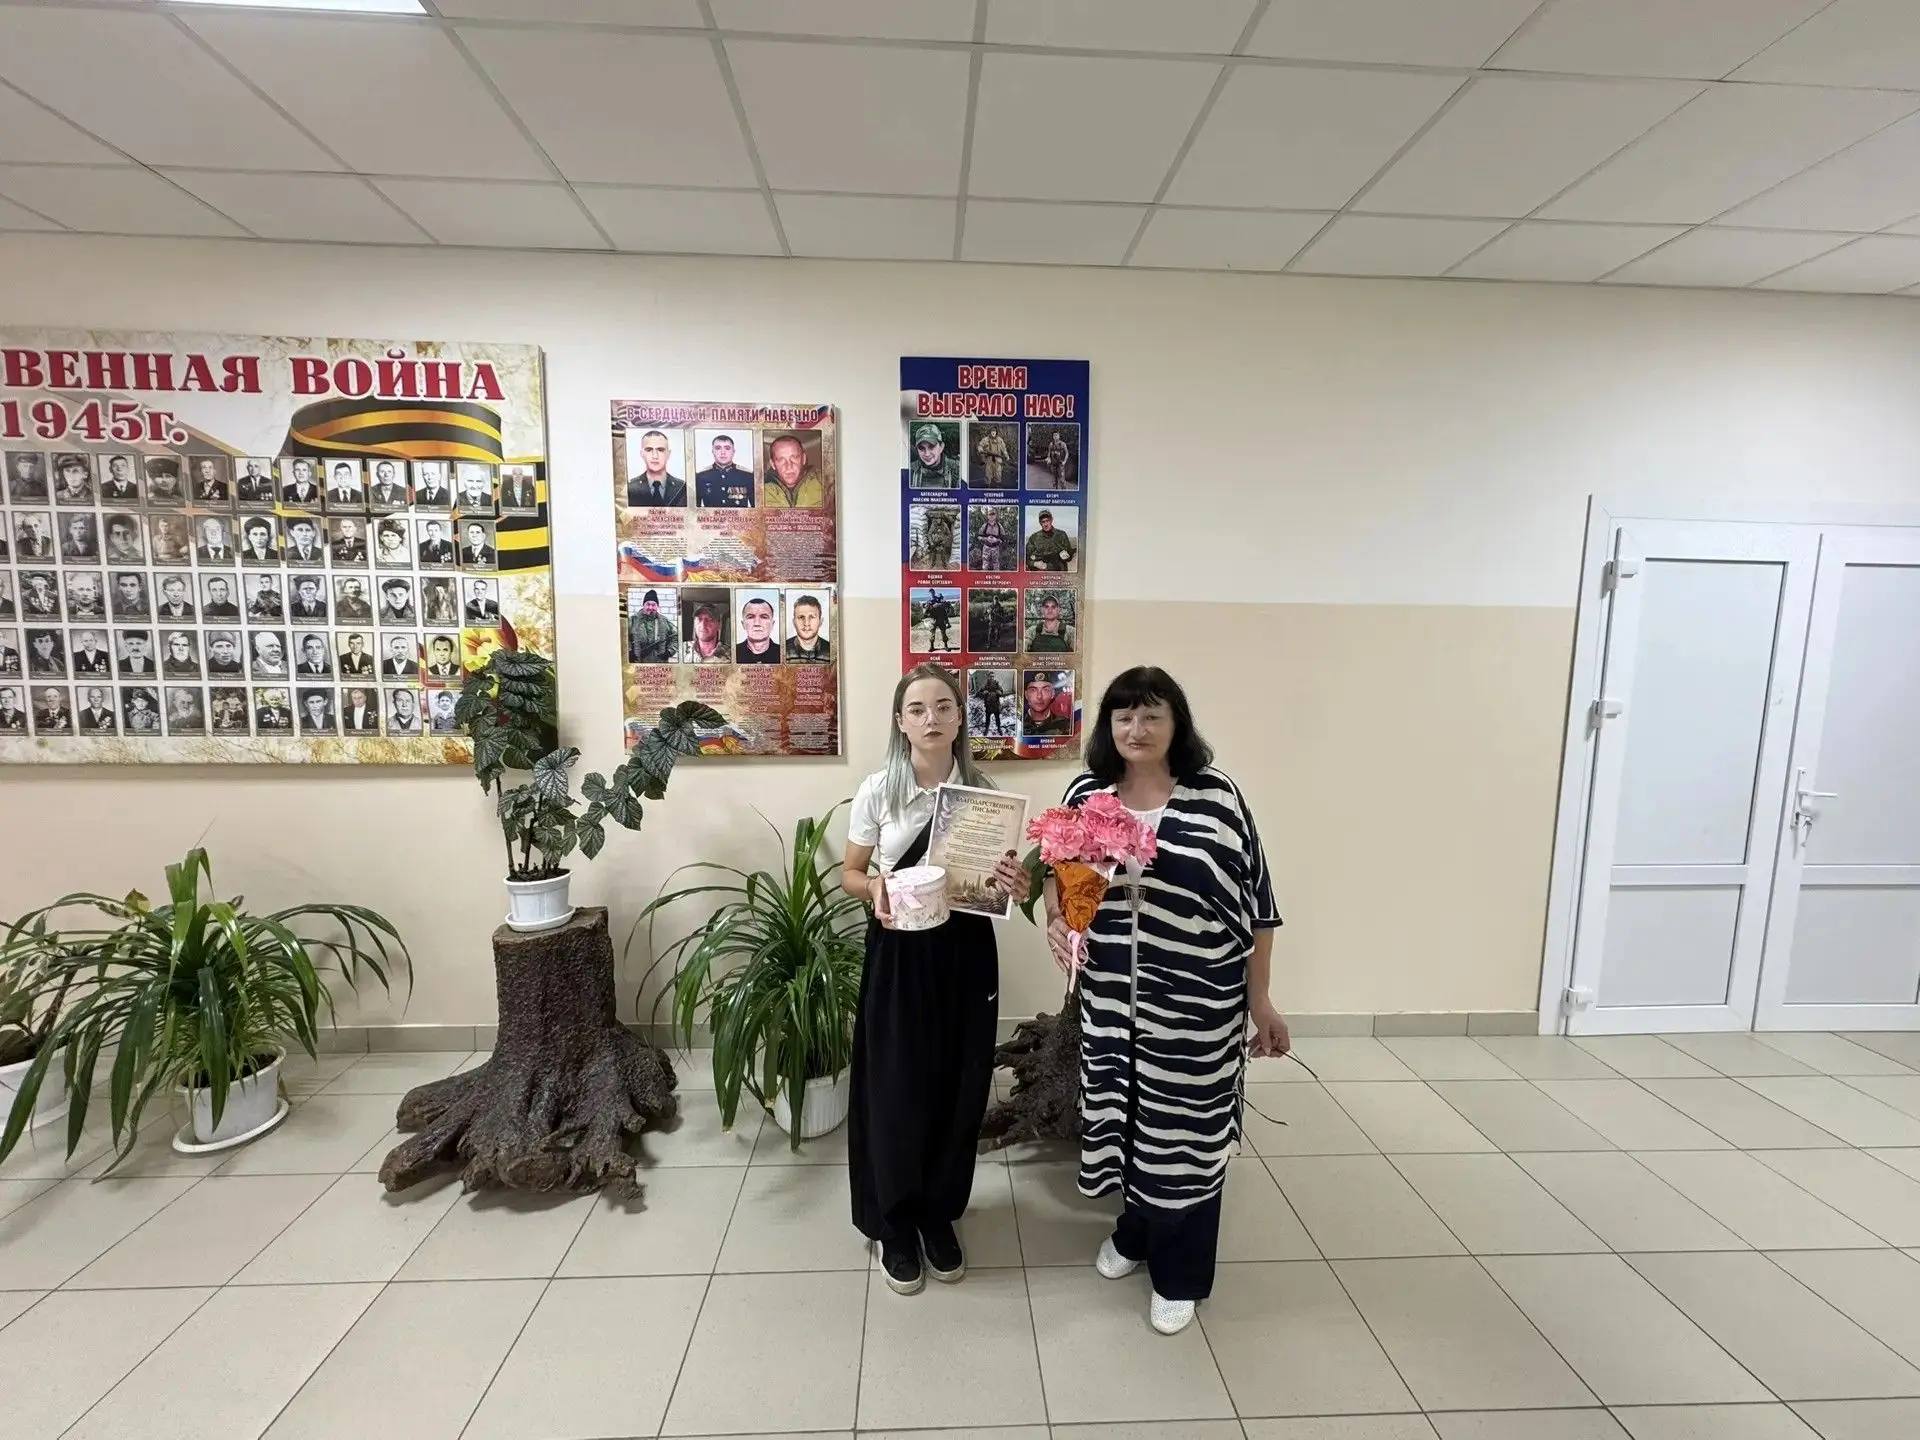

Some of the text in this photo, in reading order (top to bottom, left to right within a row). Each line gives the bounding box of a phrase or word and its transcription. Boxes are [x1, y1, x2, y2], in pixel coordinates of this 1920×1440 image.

[3, 348, 505, 401] ВЕННАЯ ВОЙНА
[958, 365, 1027, 389] ВРЕМЯ
[627, 407, 818, 422] В СЕРДЦАХ И ПАМЯТИ НАВЕЧНО
[917, 392, 1074, 418] ВЫБРАЛО НАС!
[0, 399, 187, 442] 1945г.
